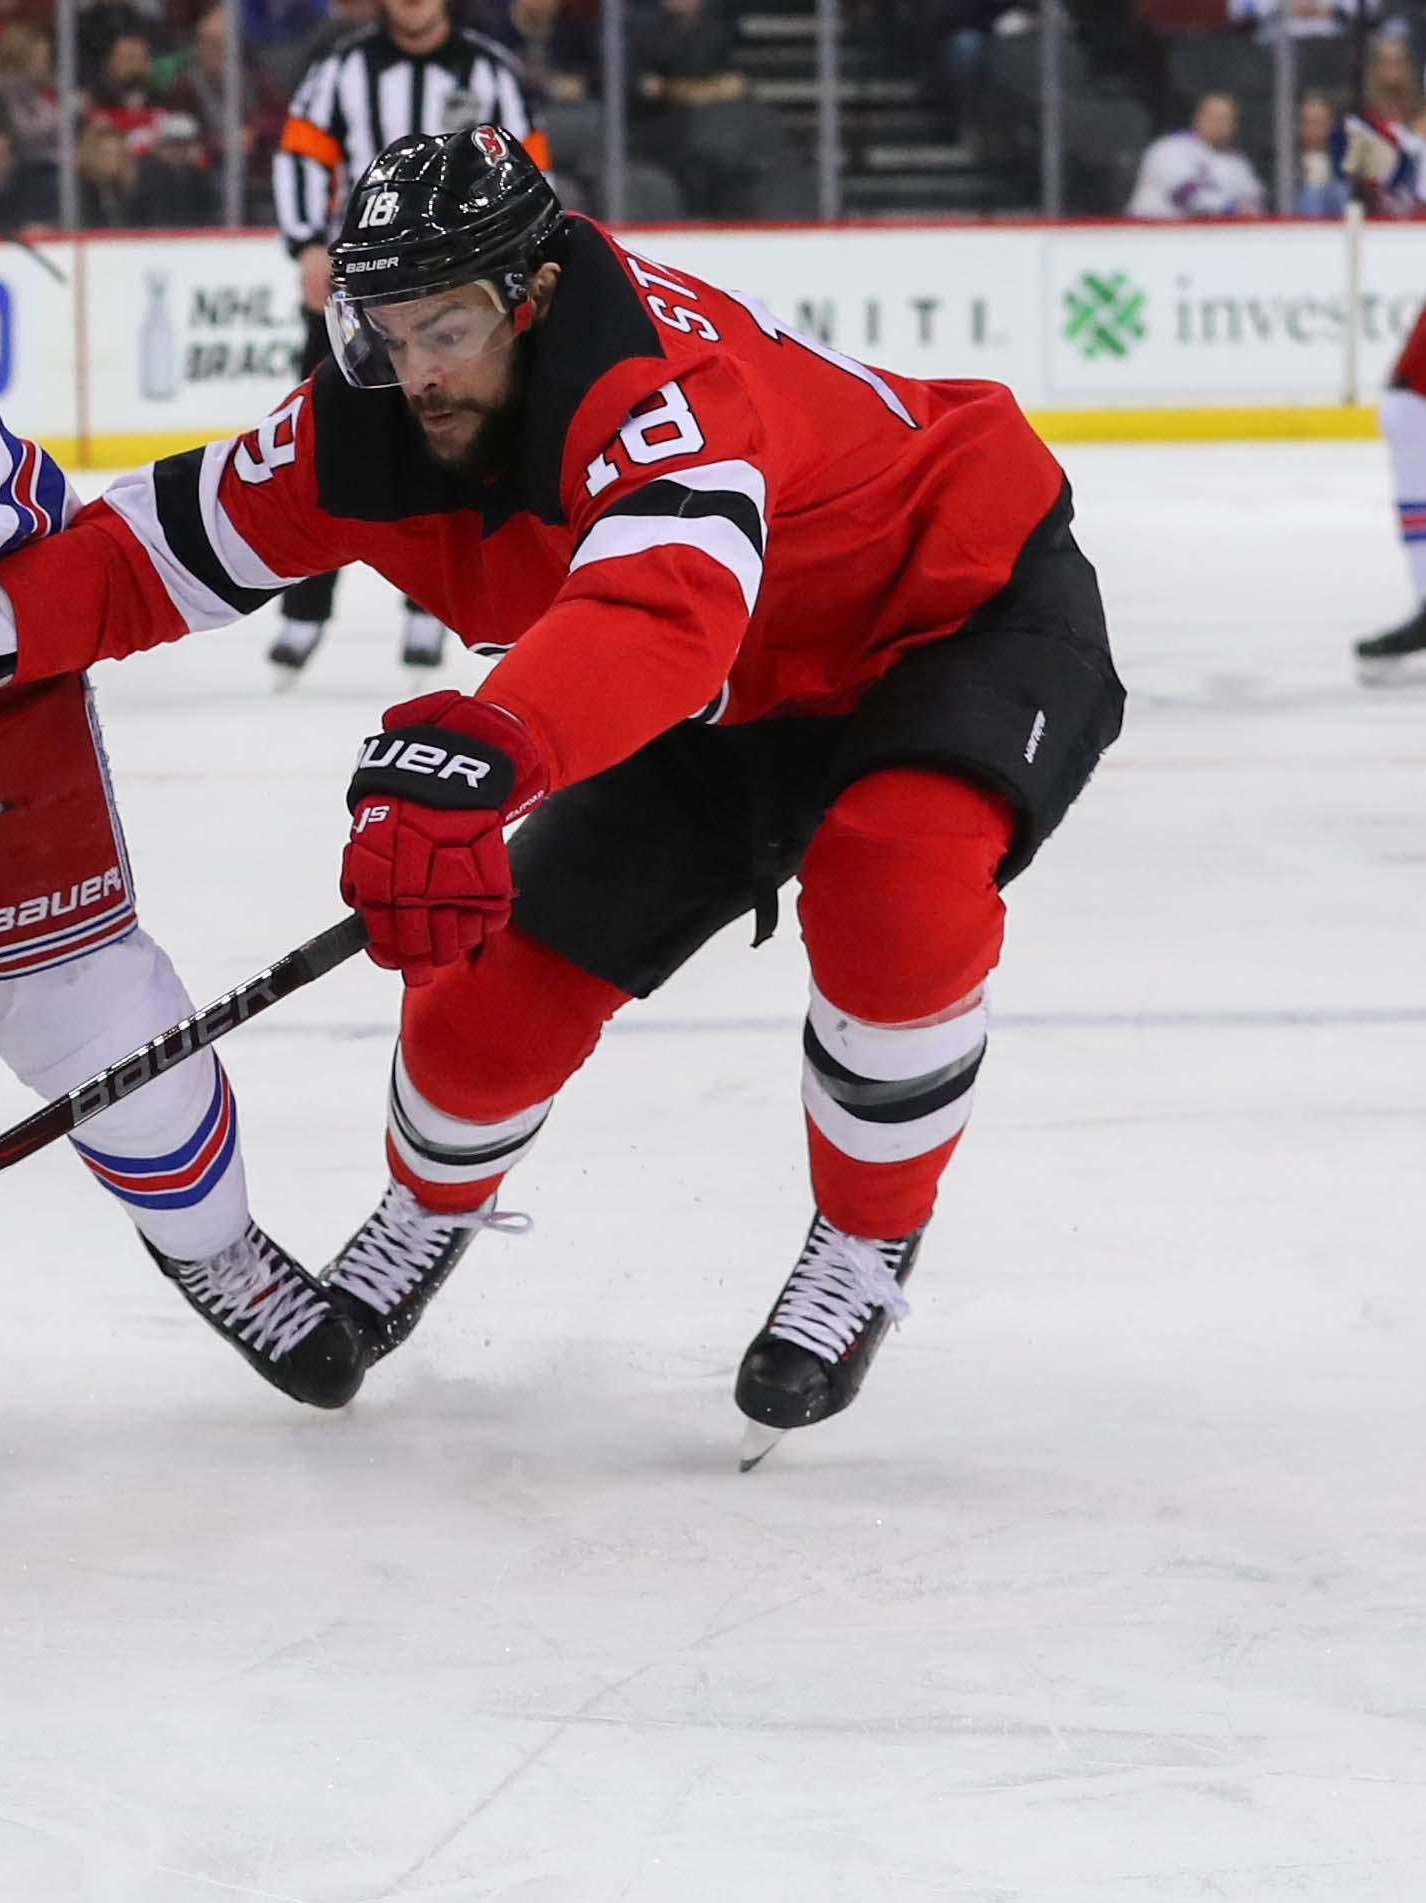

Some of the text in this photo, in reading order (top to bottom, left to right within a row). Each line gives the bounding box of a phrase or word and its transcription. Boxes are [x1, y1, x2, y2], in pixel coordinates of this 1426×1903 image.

[358, 190, 400, 229] 18
[345, 256, 399, 274] BAUER
[619, 248, 720, 342] ST
[185, 342, 302, 381] BRAC
[584, 381, 705, 498] 18
[358, 738, 491, 788] UER
[70, 968, 277, 1128] BAUER
